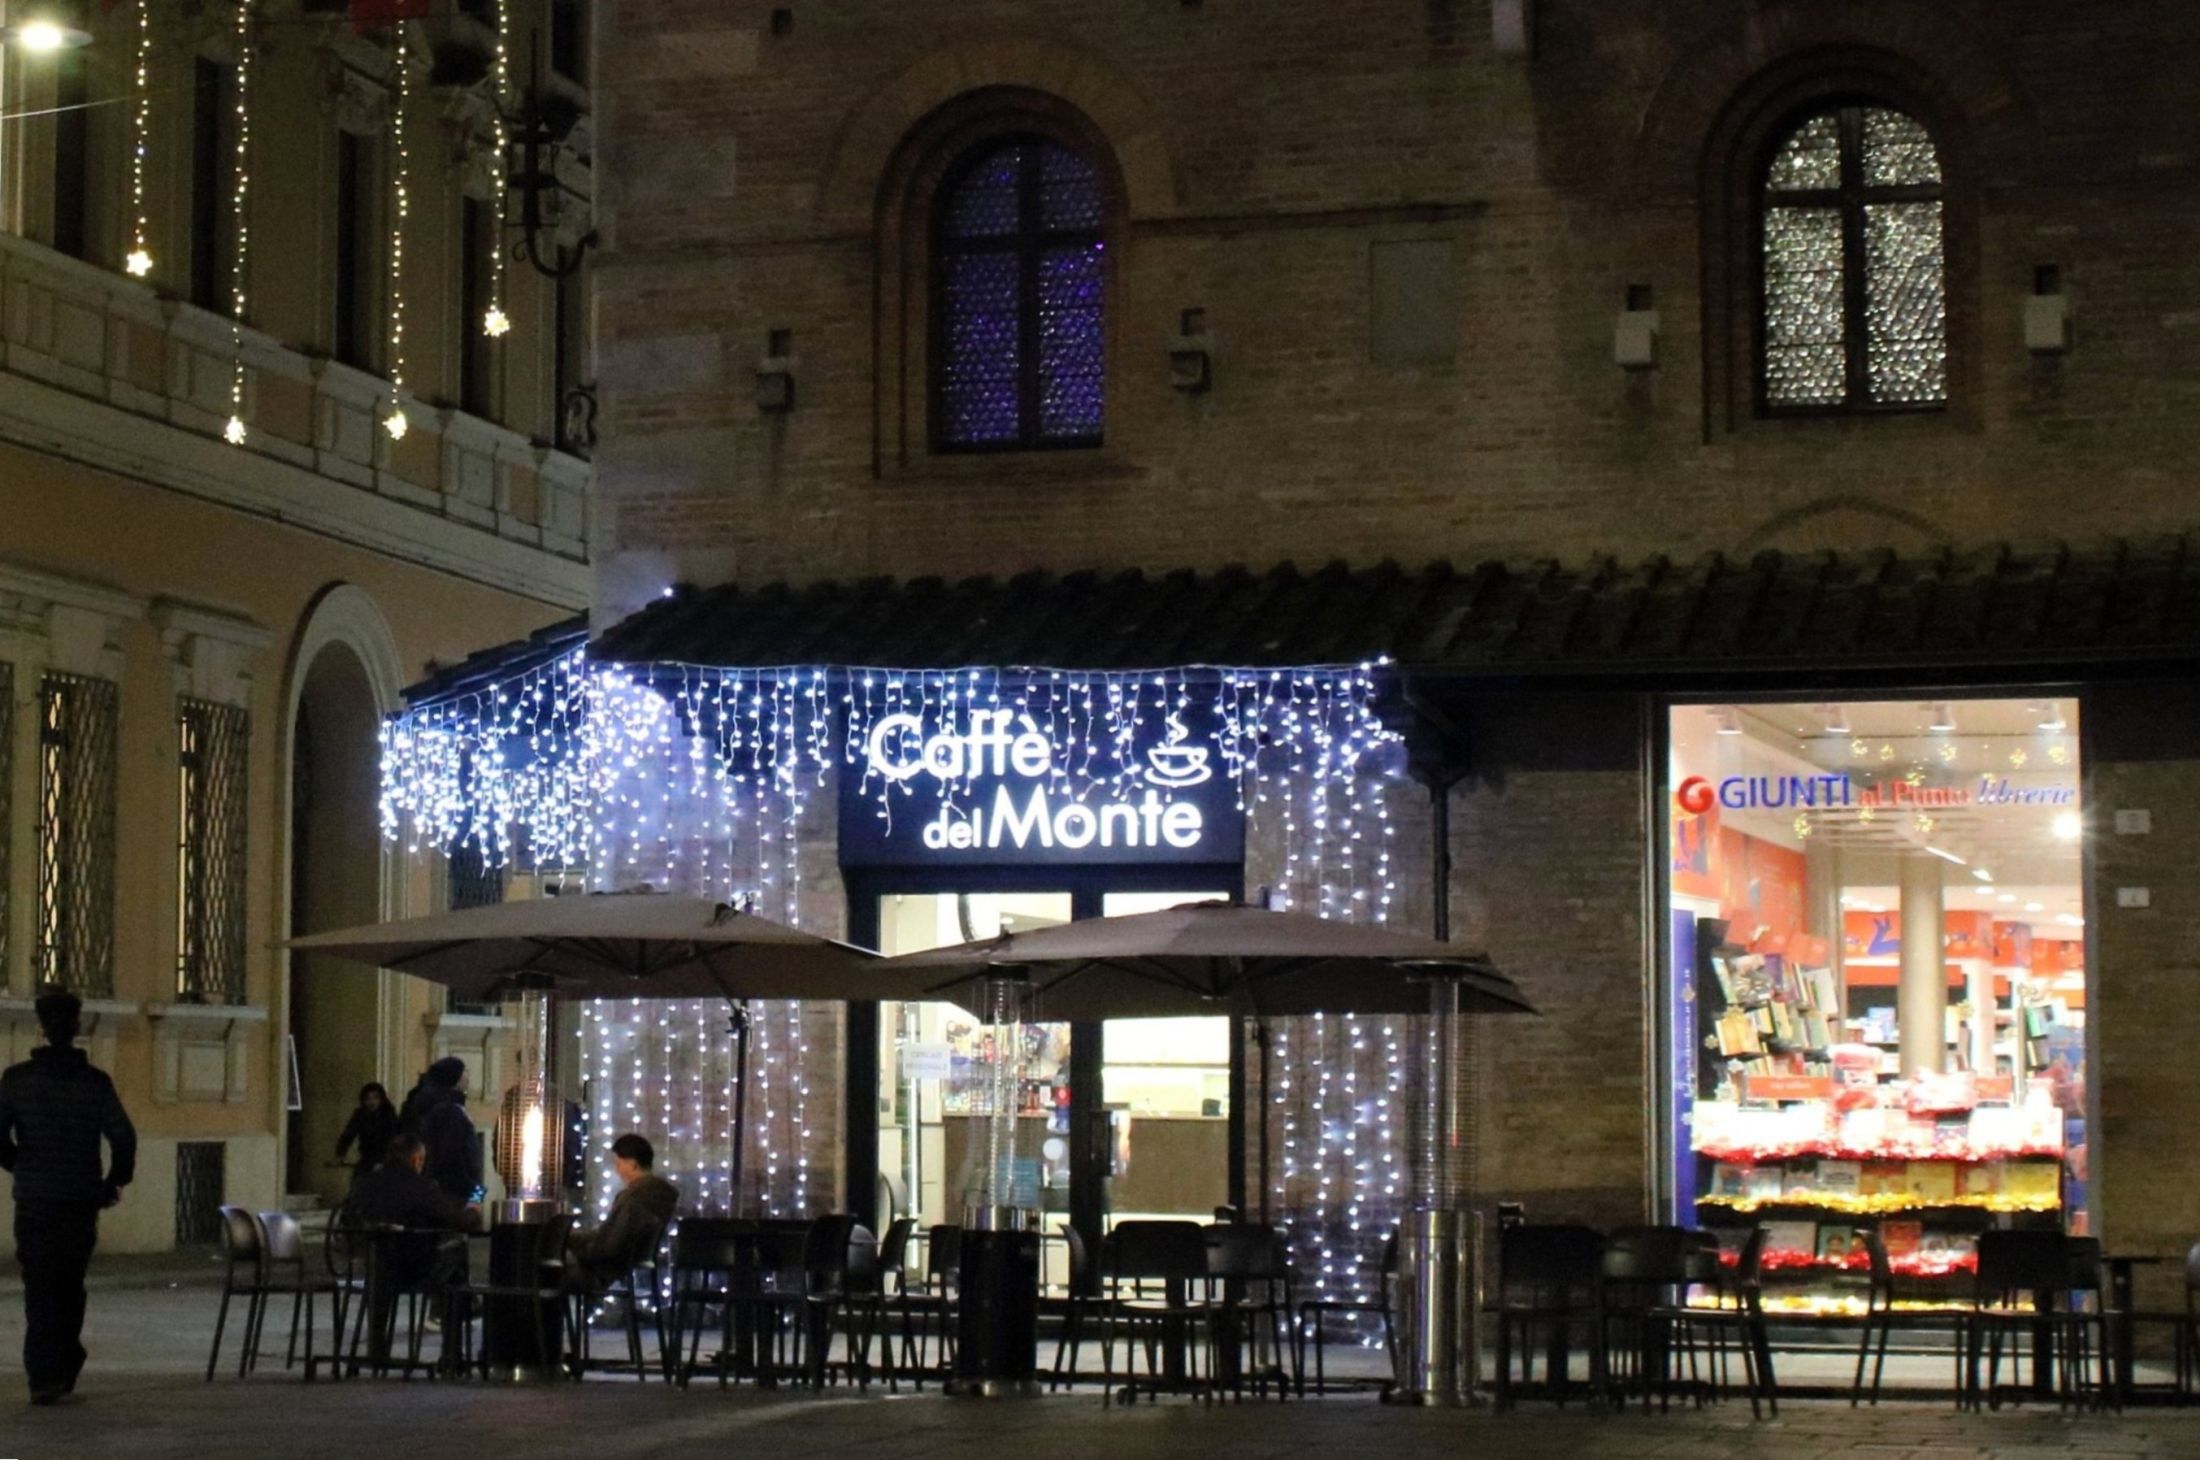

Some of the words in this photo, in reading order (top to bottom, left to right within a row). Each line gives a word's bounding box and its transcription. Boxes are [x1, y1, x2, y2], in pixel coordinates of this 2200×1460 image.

[869, 709, 1051, 779] Caffè
[923, 807, 981, 849] del
[988, 783, 1202, 849] Monte
[1719, 774, 1850, 809] GIUNTI
